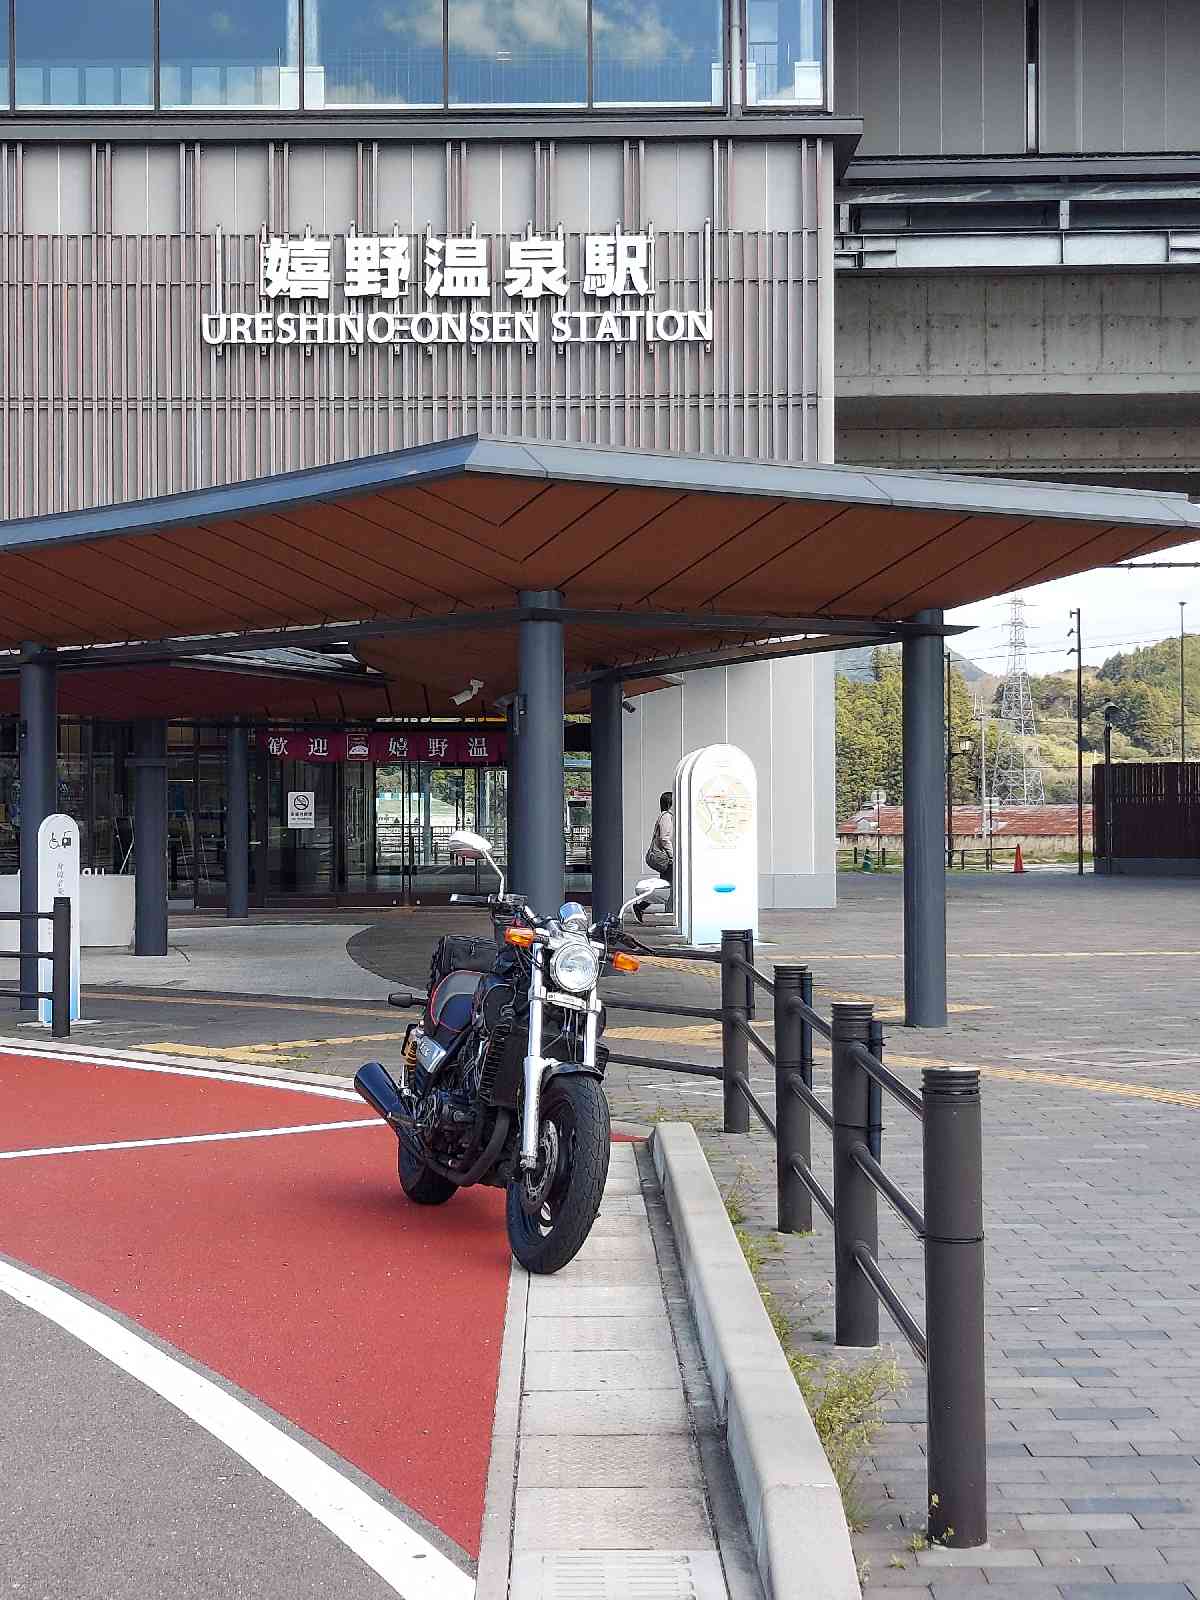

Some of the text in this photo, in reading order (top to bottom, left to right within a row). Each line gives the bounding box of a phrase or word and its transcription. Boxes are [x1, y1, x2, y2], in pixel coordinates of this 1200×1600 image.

[264, 237, 649, 299] 嬉野温泉駅
[201, 310, 714, 345] URESHINO-ONSEN STATION
[268, 737, 329, 756] 歓迎
